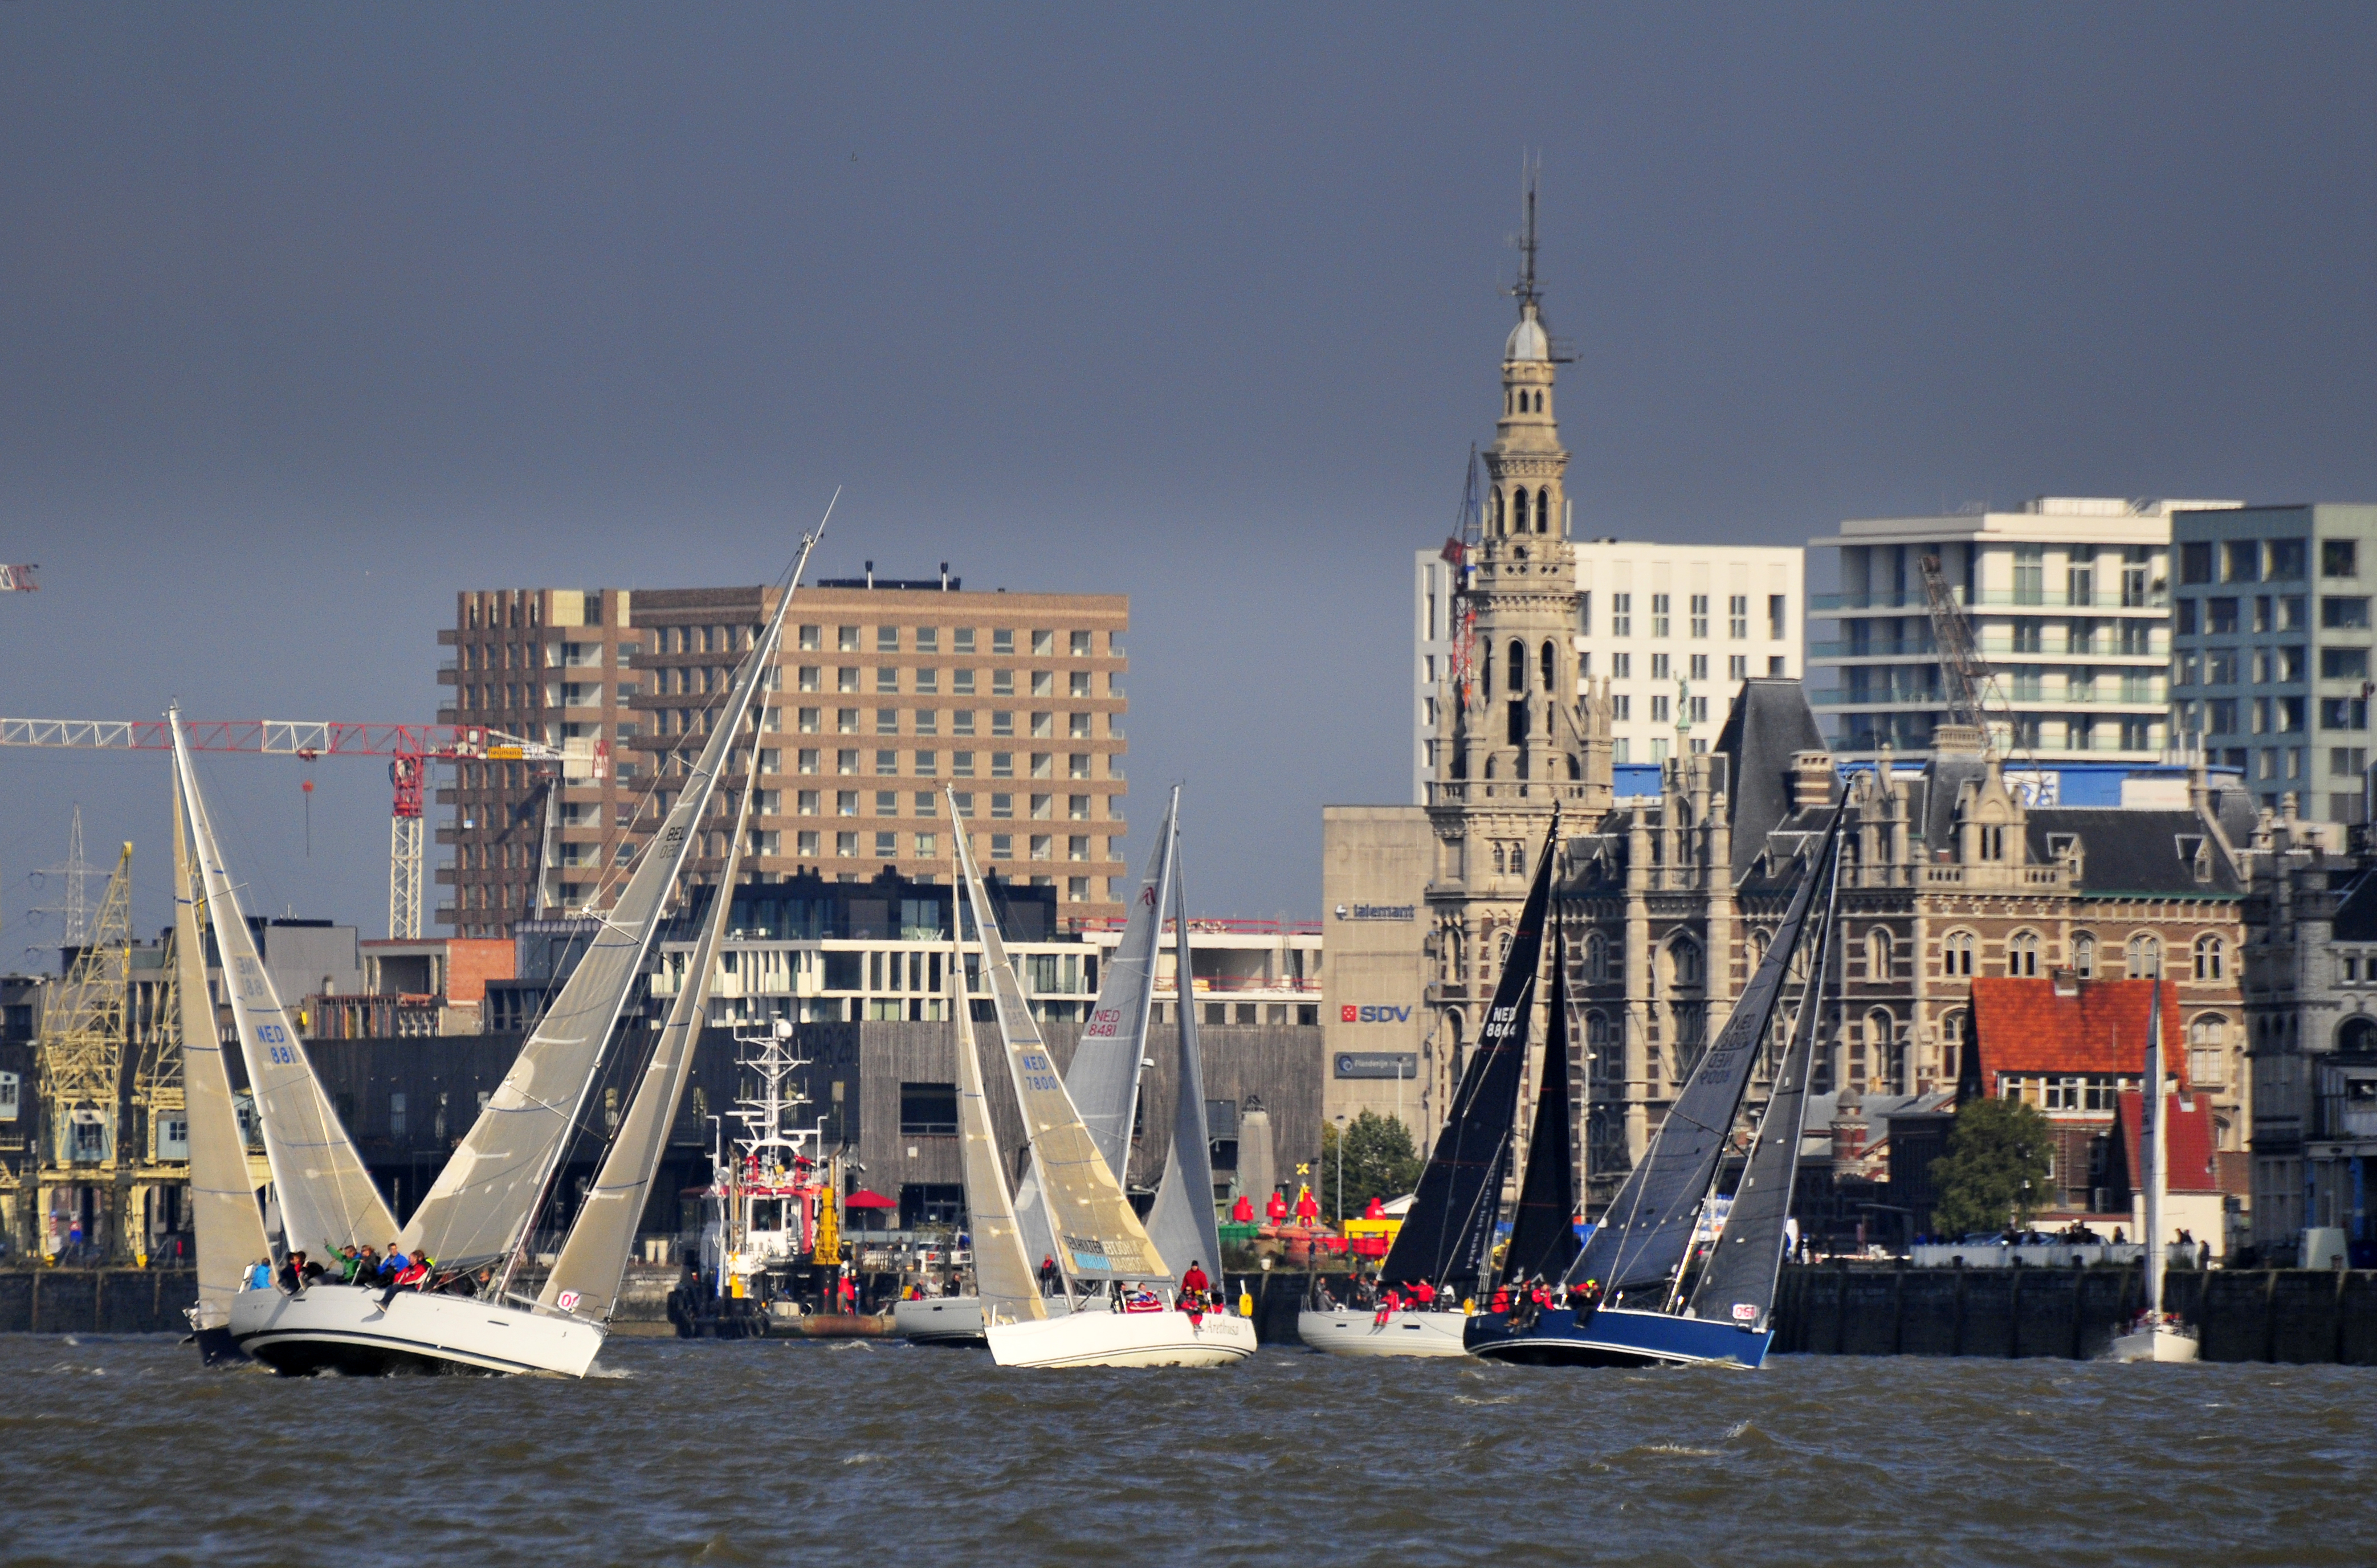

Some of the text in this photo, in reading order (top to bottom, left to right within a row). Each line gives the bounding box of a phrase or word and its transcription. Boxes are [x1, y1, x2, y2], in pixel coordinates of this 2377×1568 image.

[666, 826, 684, 841] BEL
[1353, 904, 1414, 917] lalemant
[1094, 1010, 1120, 1022] NED
[1360, 1006, 1412, 1022] SDV
[1493, 1007, 1516, 1022] NED
[257, 1025, 285, 1043] NED
[1088, 1024, 1117, 1037] 8481
[1486, 1023, 1516, 1038] 8844
[270, 1046, 297, 1064] 881
[1023, 1056, 1046, 1070] NED
[1026, 1076, 1058, 1090] 7800
